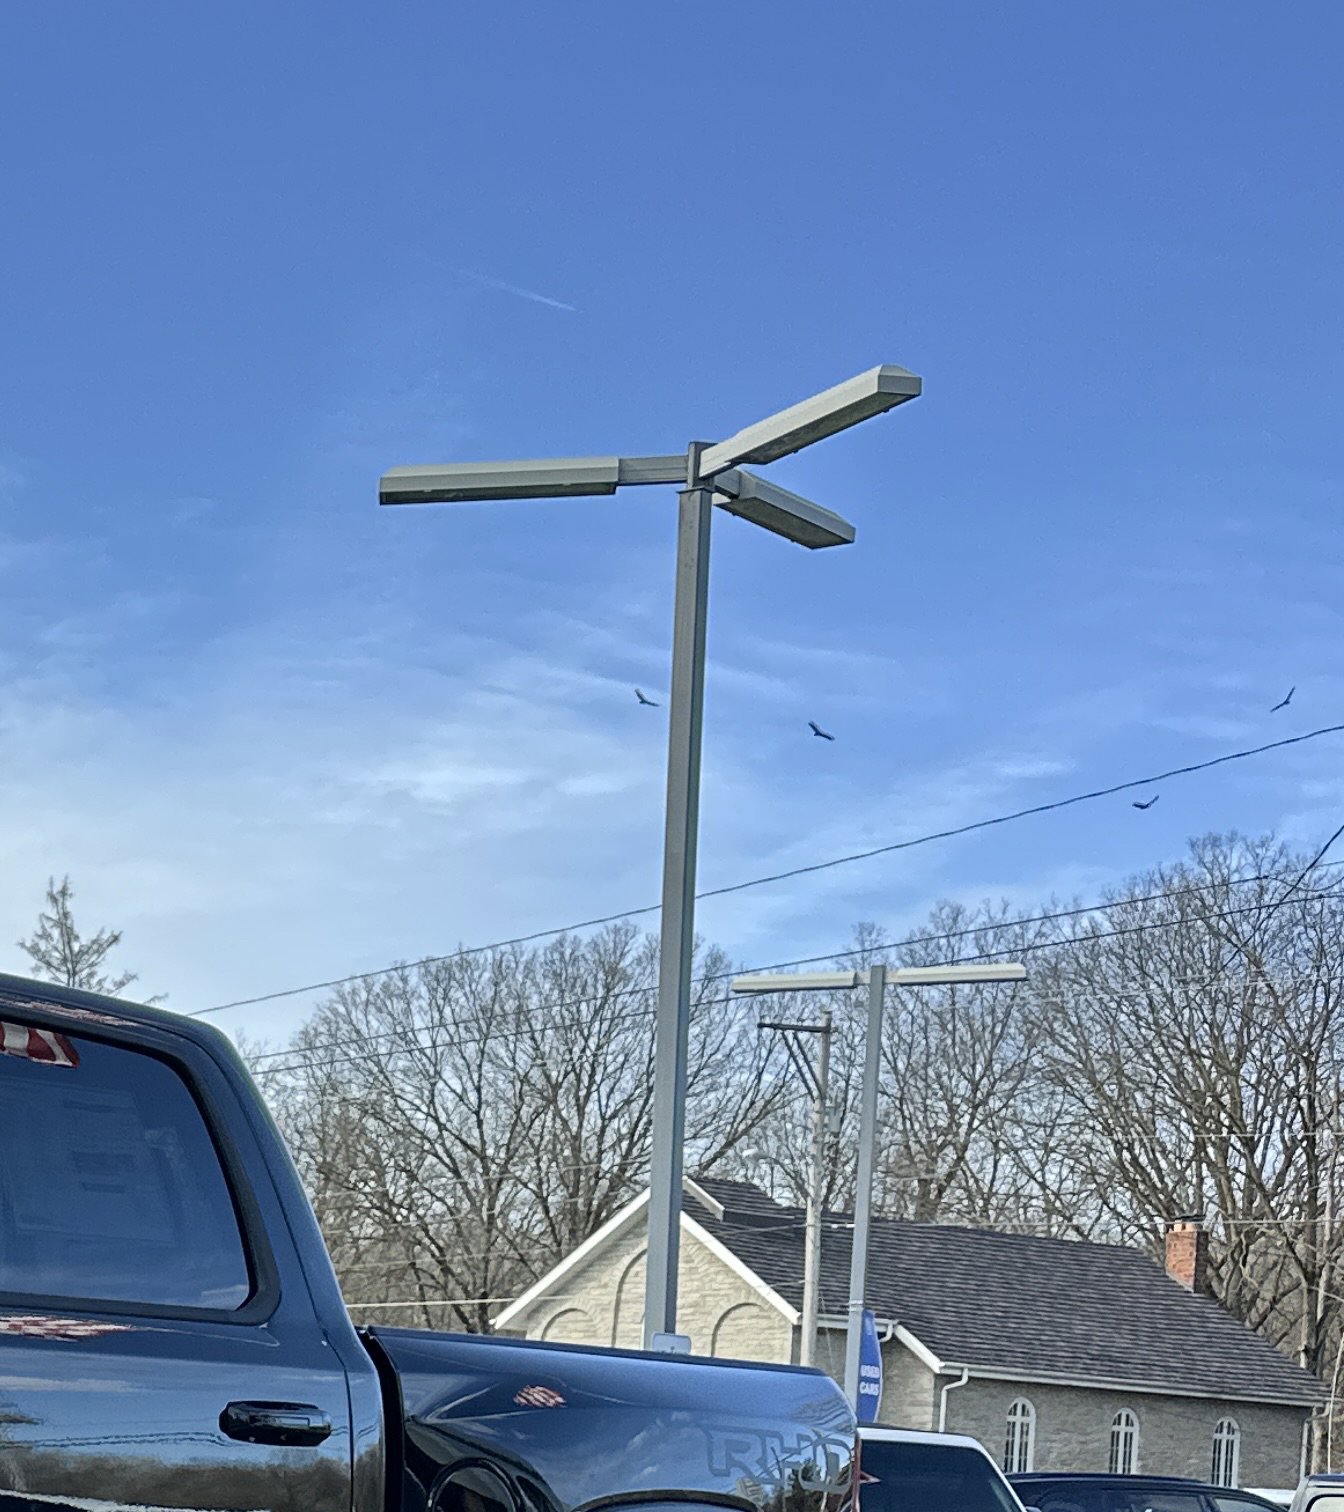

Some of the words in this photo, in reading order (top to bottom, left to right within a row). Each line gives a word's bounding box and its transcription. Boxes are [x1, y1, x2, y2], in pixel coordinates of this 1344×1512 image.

[861, 1365, 880, 1378] USED
[859, 1382, 879, 1396] CARS
[706, 1427, 853, 1492] RHO
